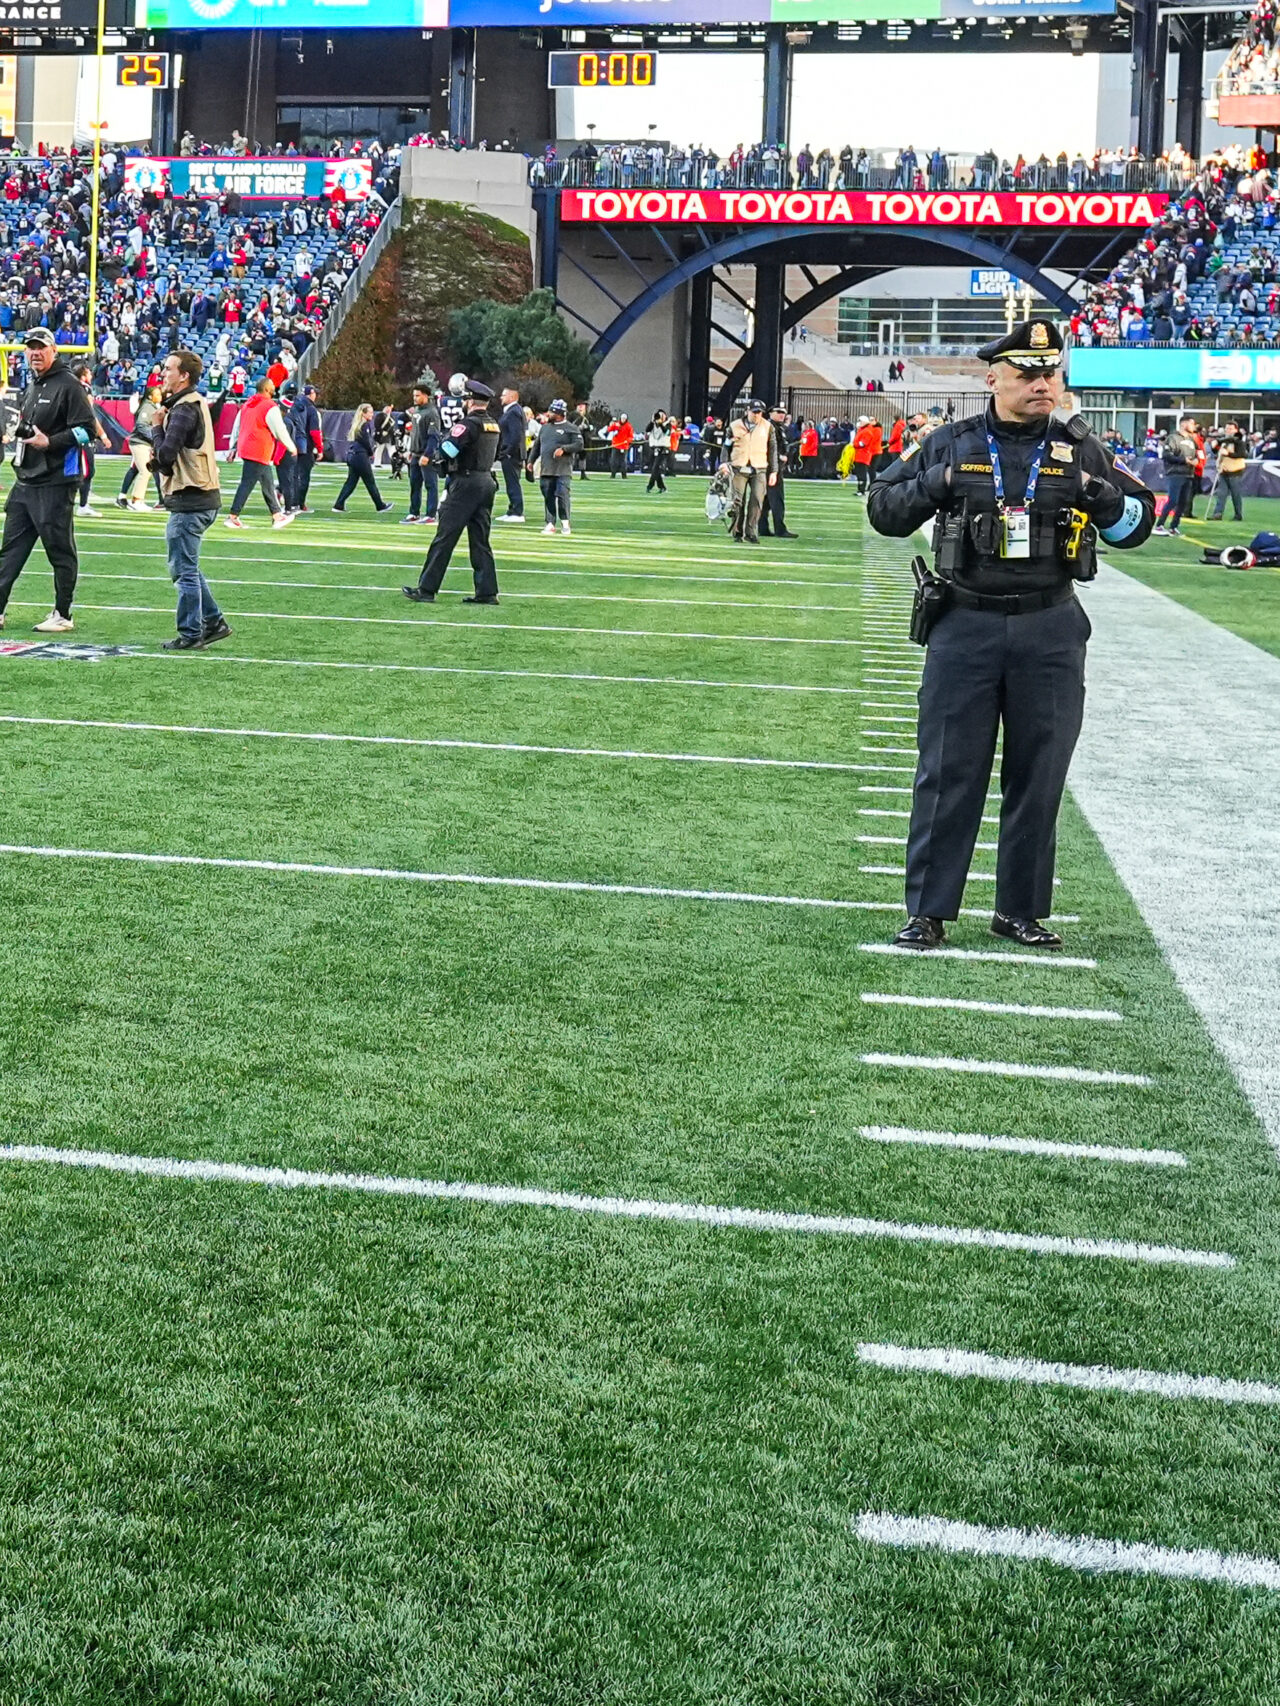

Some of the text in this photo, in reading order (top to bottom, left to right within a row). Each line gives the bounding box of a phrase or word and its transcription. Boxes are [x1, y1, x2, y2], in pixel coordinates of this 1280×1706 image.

[121, 55, 161, 86] 25
[578, 53, 652, 87] 0:00
[189, 175, 306, 195] U.S. AIR FORCE
[577, 192, 1156, 224] TOYOTA TOYOTA TOYOTA TOYOTA
[343, 258, 353, 269] 12
[978, 270, 1011, 283] BUD
[972, 281, 1016, 295] LIGHT
[1039, 466, 1065, 476] POLICE
